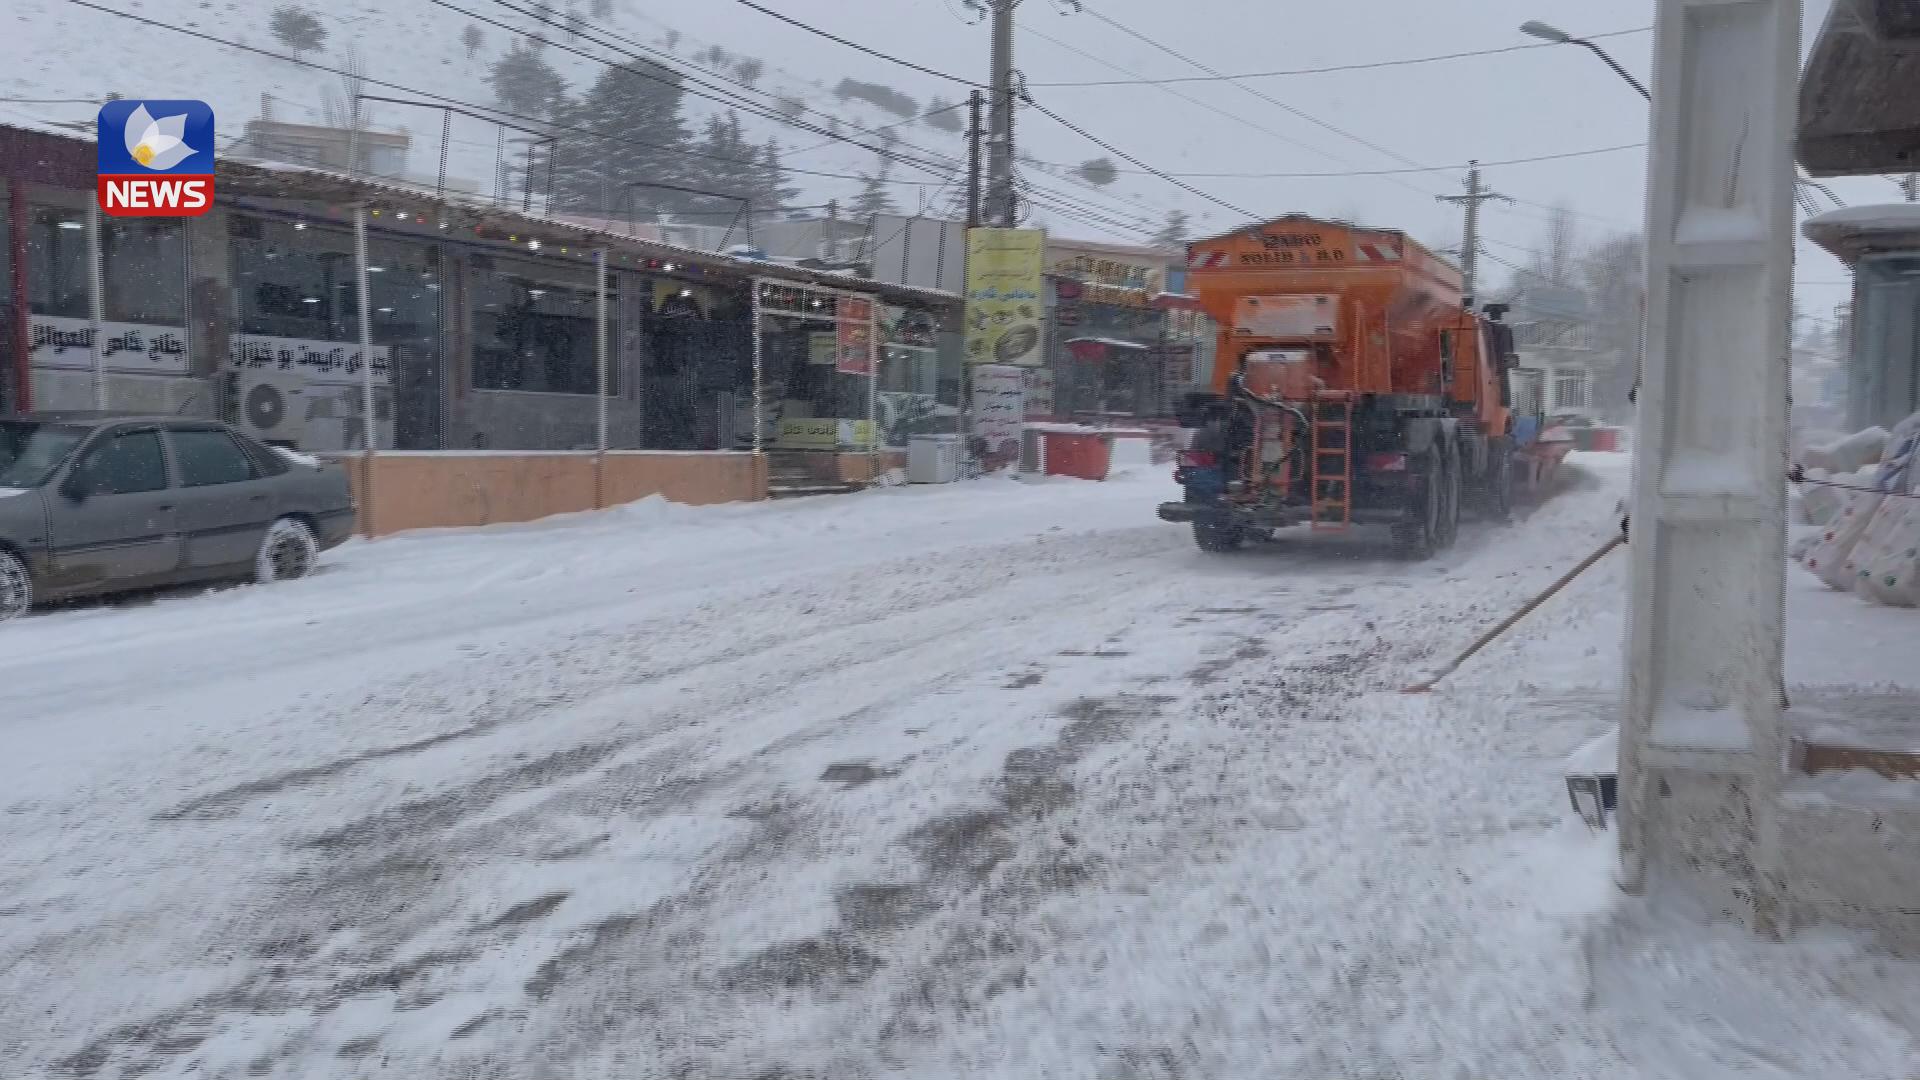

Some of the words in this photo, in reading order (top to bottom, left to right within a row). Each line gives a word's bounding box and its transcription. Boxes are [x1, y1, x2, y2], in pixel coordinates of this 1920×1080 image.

[1239, 249, 1294, 264] SOLID
[101, 329, 146, 357] خاص
[148, 333, 188, 362] جناح
